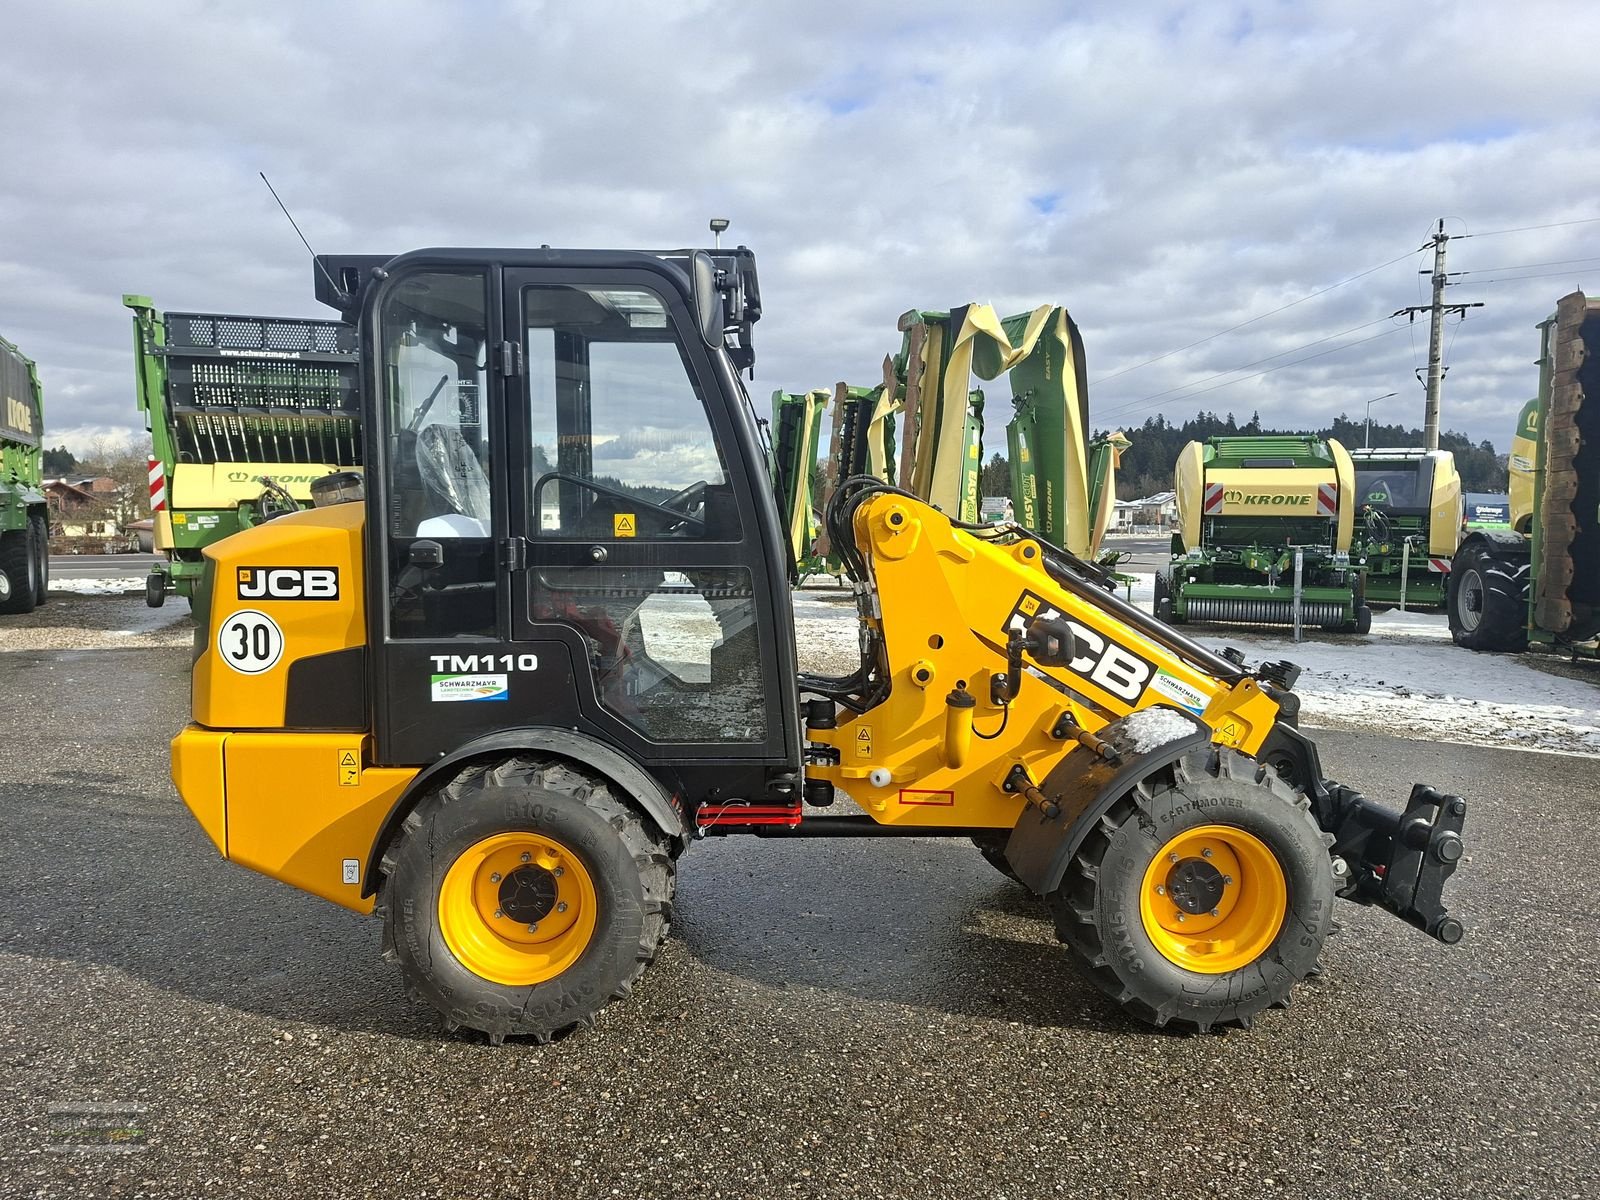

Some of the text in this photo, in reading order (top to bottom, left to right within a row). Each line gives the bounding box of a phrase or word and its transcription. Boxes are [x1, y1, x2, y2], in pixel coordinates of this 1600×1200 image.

[1243, 494, 1312, 505] KRONE
[239, 569, 338, 598] JCB
[231, 623, 270, 661] 30
[430, 654, 539, 672] TM110
[439, 680, 497, 688] SCHWARZMAYR
[1159, 675, 1202, 702] SCHWARZMAYR
[1160, 797, 1244, 824] EARTHMOVER
[1300, 901, 1323, 948] R105
